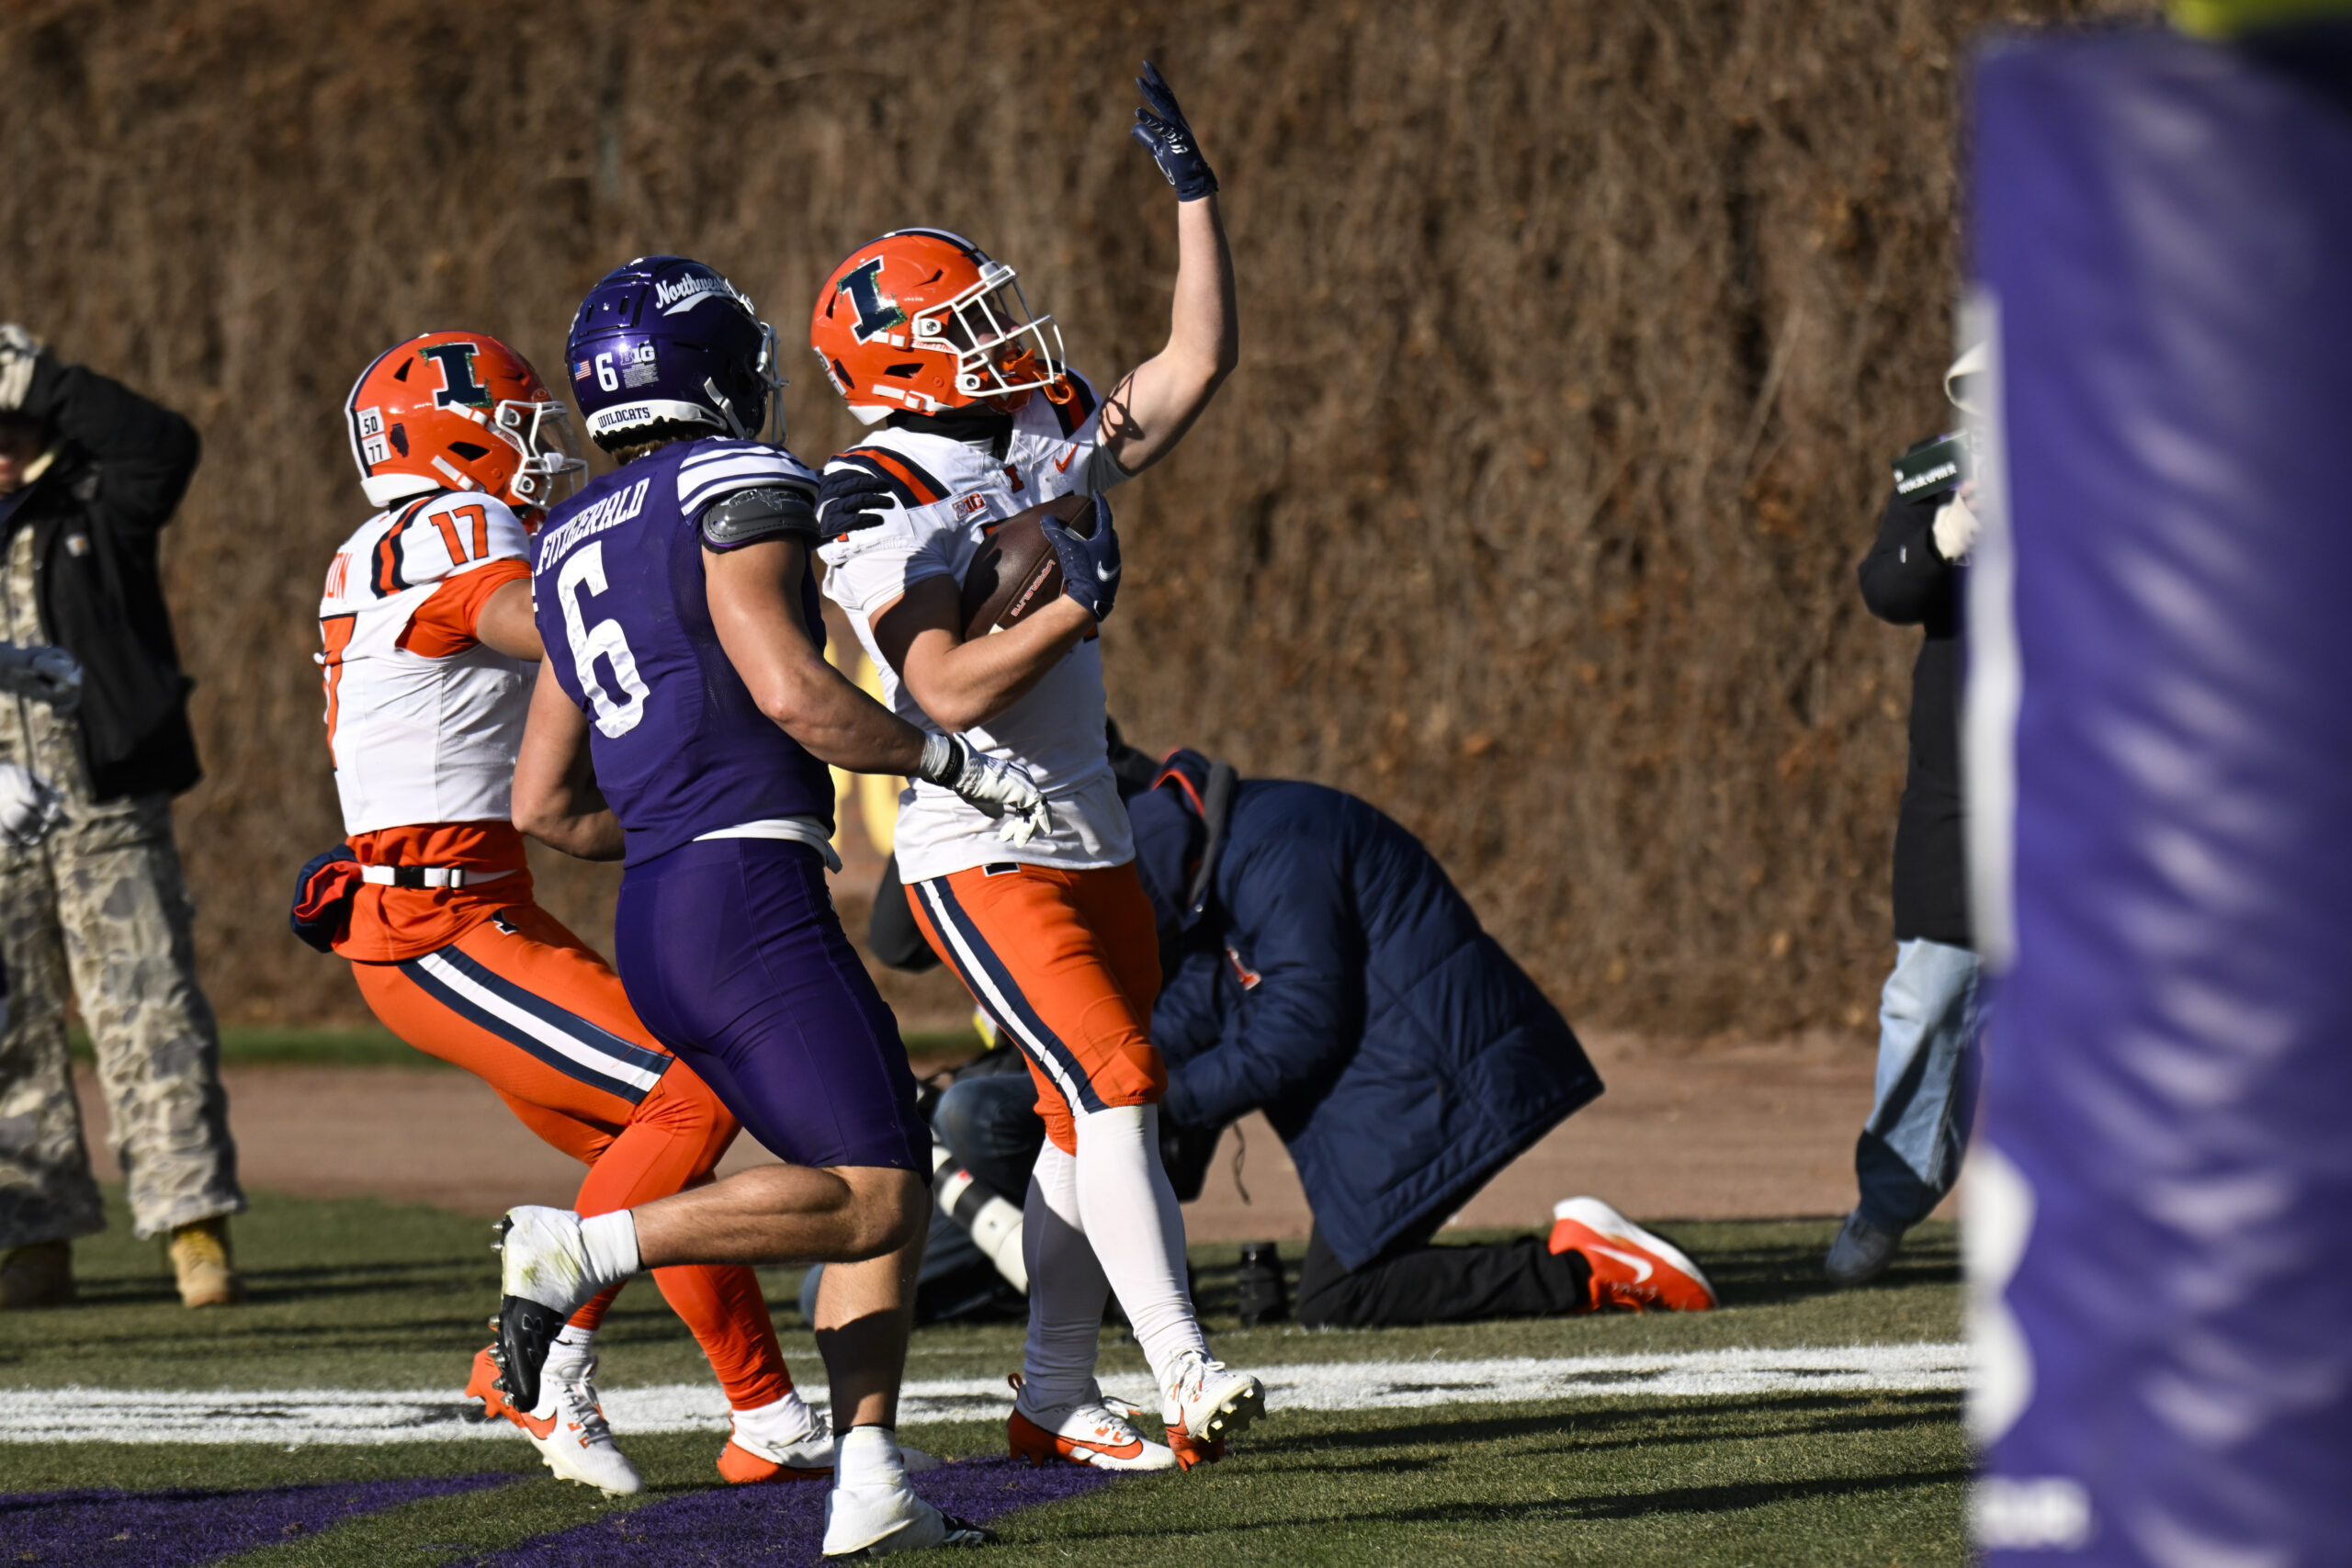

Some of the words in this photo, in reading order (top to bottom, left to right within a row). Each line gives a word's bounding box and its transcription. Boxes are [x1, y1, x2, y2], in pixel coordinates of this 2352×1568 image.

[595, 352, 619, 392] 6
[364, 415, 379, 434] 50
[598, 407, 651, 429] WILDCATS
[368, 444, 383, 463] 77
[429, 504, 489, 567] 17
[536, 478, 650, 577] FITZGERALD
[557, 539, 650, 739] 6
